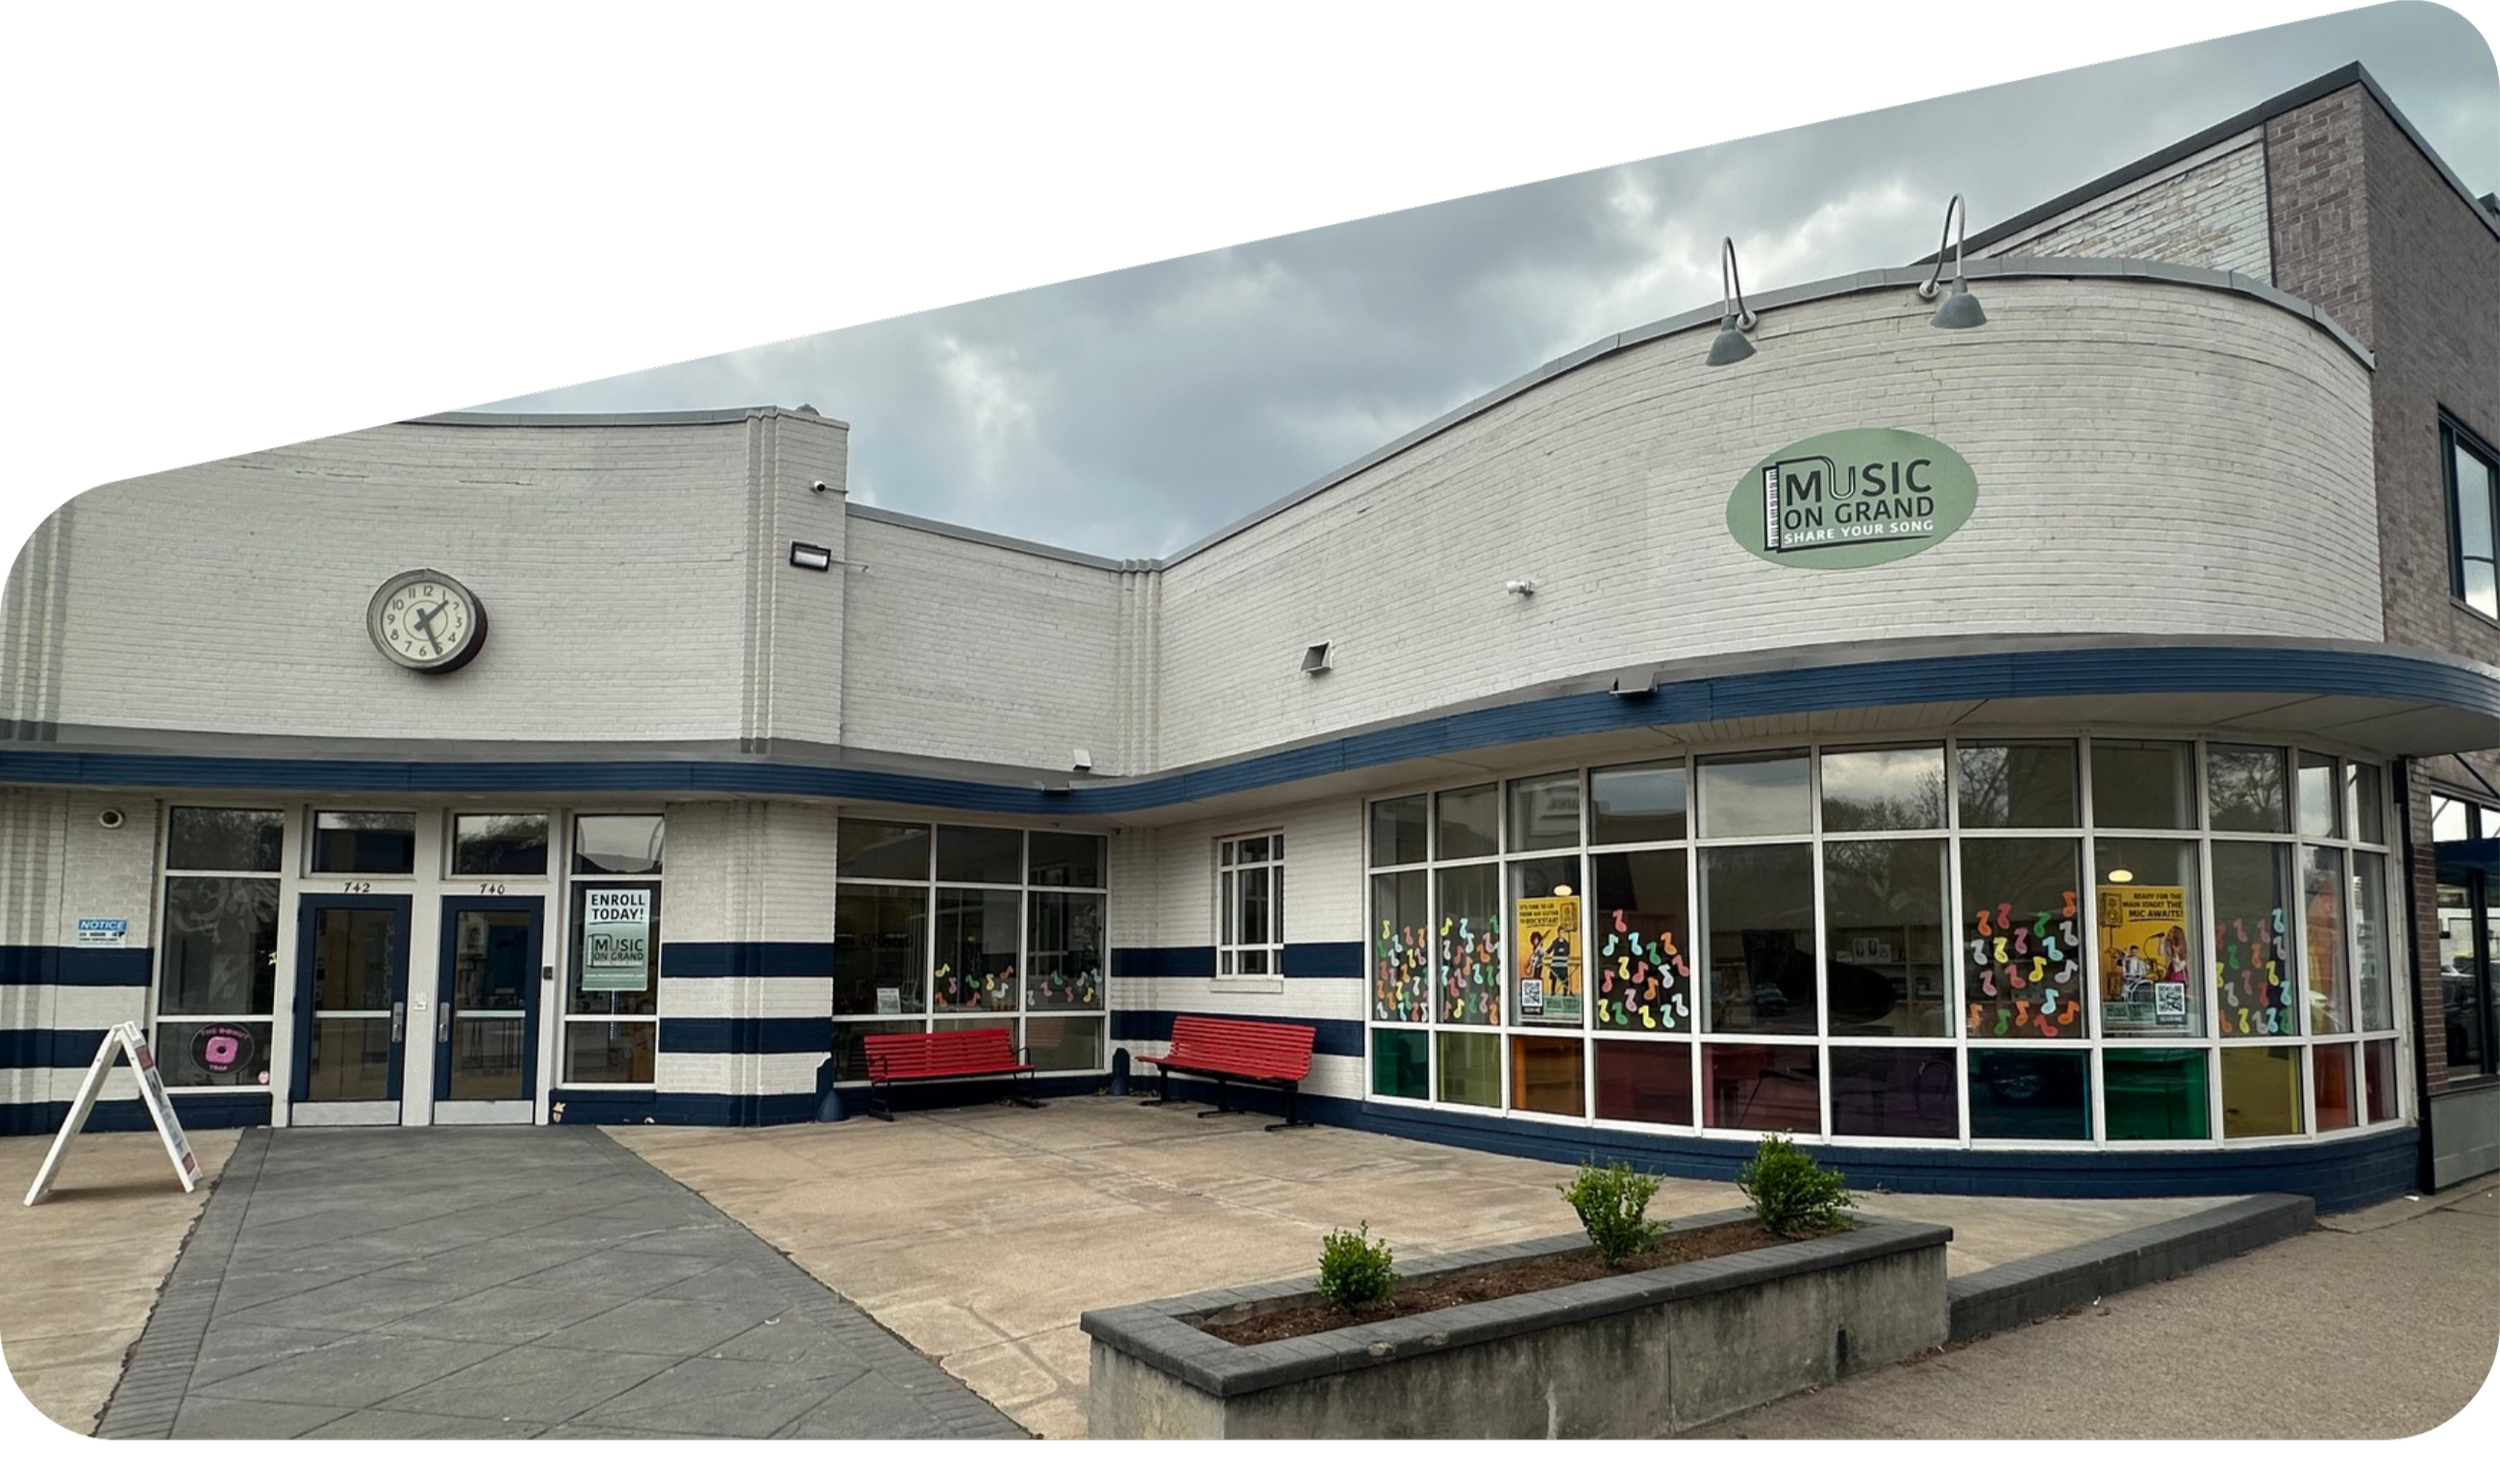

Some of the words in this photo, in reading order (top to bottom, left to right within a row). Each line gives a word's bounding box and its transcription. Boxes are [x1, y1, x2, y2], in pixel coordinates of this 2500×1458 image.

[1786, 457, 1932, 506] MUSIC
[1784, 506, 1823, 530] ON
[1835, 496, 1935, 524] GRAND
[1784, 527, 1835, 545] SHARE
[1841, 524, 1884, 538] YOUR
[1890, 520, 1934, 533] SONG
[409, 588, 416, 599] 11
[424, 585, 434, 596] 12
[393, 599, 404, 610] 10
[387, 614, 395, 625] 9
[455, 616, 462, 629] 3
[391, 630, 399, 640] 8
[449, 632, 456, 643] 4
[404, 641, 413, 652] 7
[419, 646, 427, 657] 6
[344, 881, 371, 893] 742
[480, 883, 505, 895] 740
[591, 894, 645, 906] ENROLL
[2167, 901, 2183, 909] THE
[592, 908, 644, 920] TODAY!
[80, 921, 126, 930] NOTICE
[595, 938, 644, 952] MUSIC
[594, 952, 608, 961] ON
[611, 952, 644, 961] GRAND
